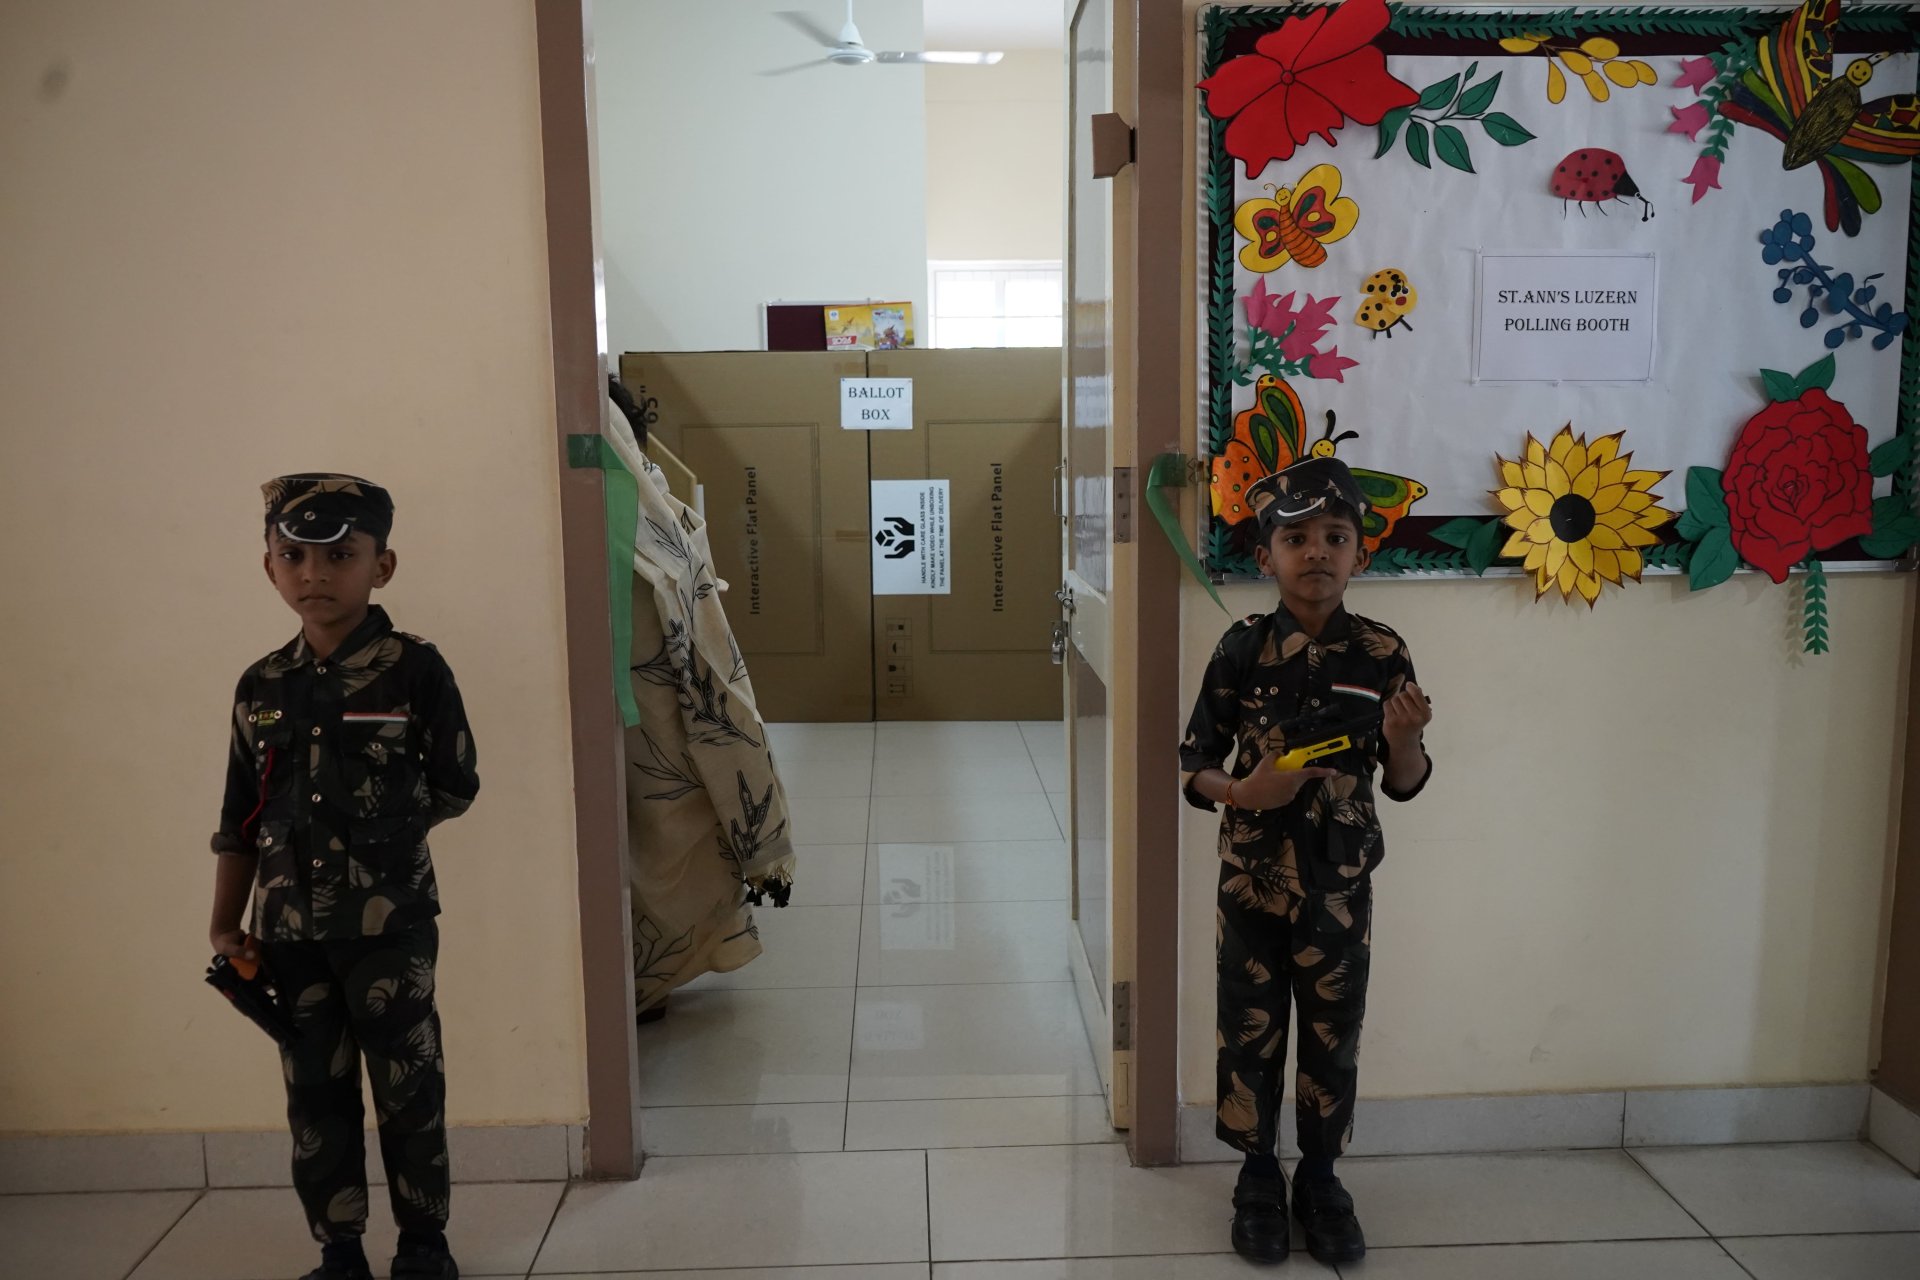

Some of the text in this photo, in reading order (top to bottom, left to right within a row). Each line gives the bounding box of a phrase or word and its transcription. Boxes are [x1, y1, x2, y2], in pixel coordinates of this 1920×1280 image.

[1498, 290, 1638, 304] ST.ANN'S LUZERN
[1504, 318, 1630, 331] POLLING BOOTH
[848, 387, 904, 398] BALLOT
[861, 409, 890, 420] BOX
[744, 467, 760, 615] Interactive Flat Panel
[990, 463, 1003, 612] Interactive Flat Panel
